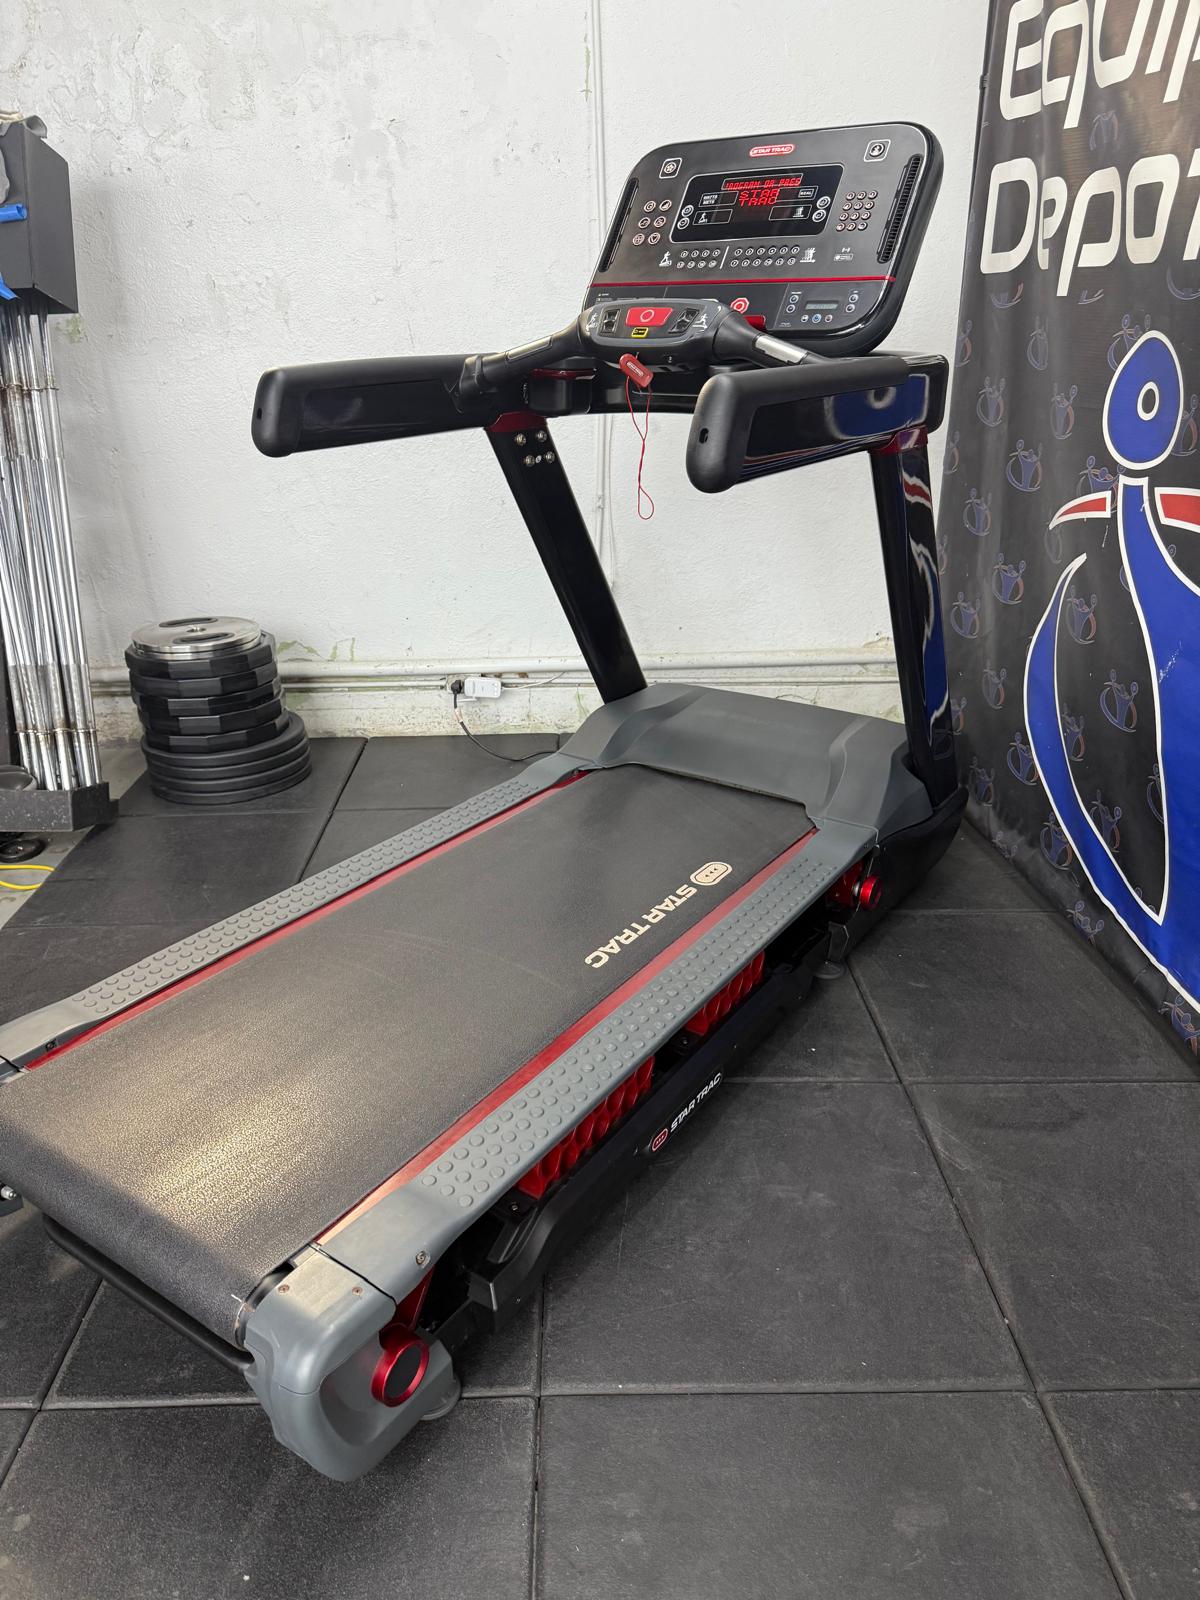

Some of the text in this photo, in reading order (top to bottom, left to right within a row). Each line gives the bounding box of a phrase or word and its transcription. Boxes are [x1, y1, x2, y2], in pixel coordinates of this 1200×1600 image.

[739, 197, 777, 207] TRAC
[740, 189, 779, 199] STAR
[980, 148, 1200, 297] Depo
[584, 884, 698, 969] STAR TRAC
[670, 1072, 722, 1133] STAR TRAC
